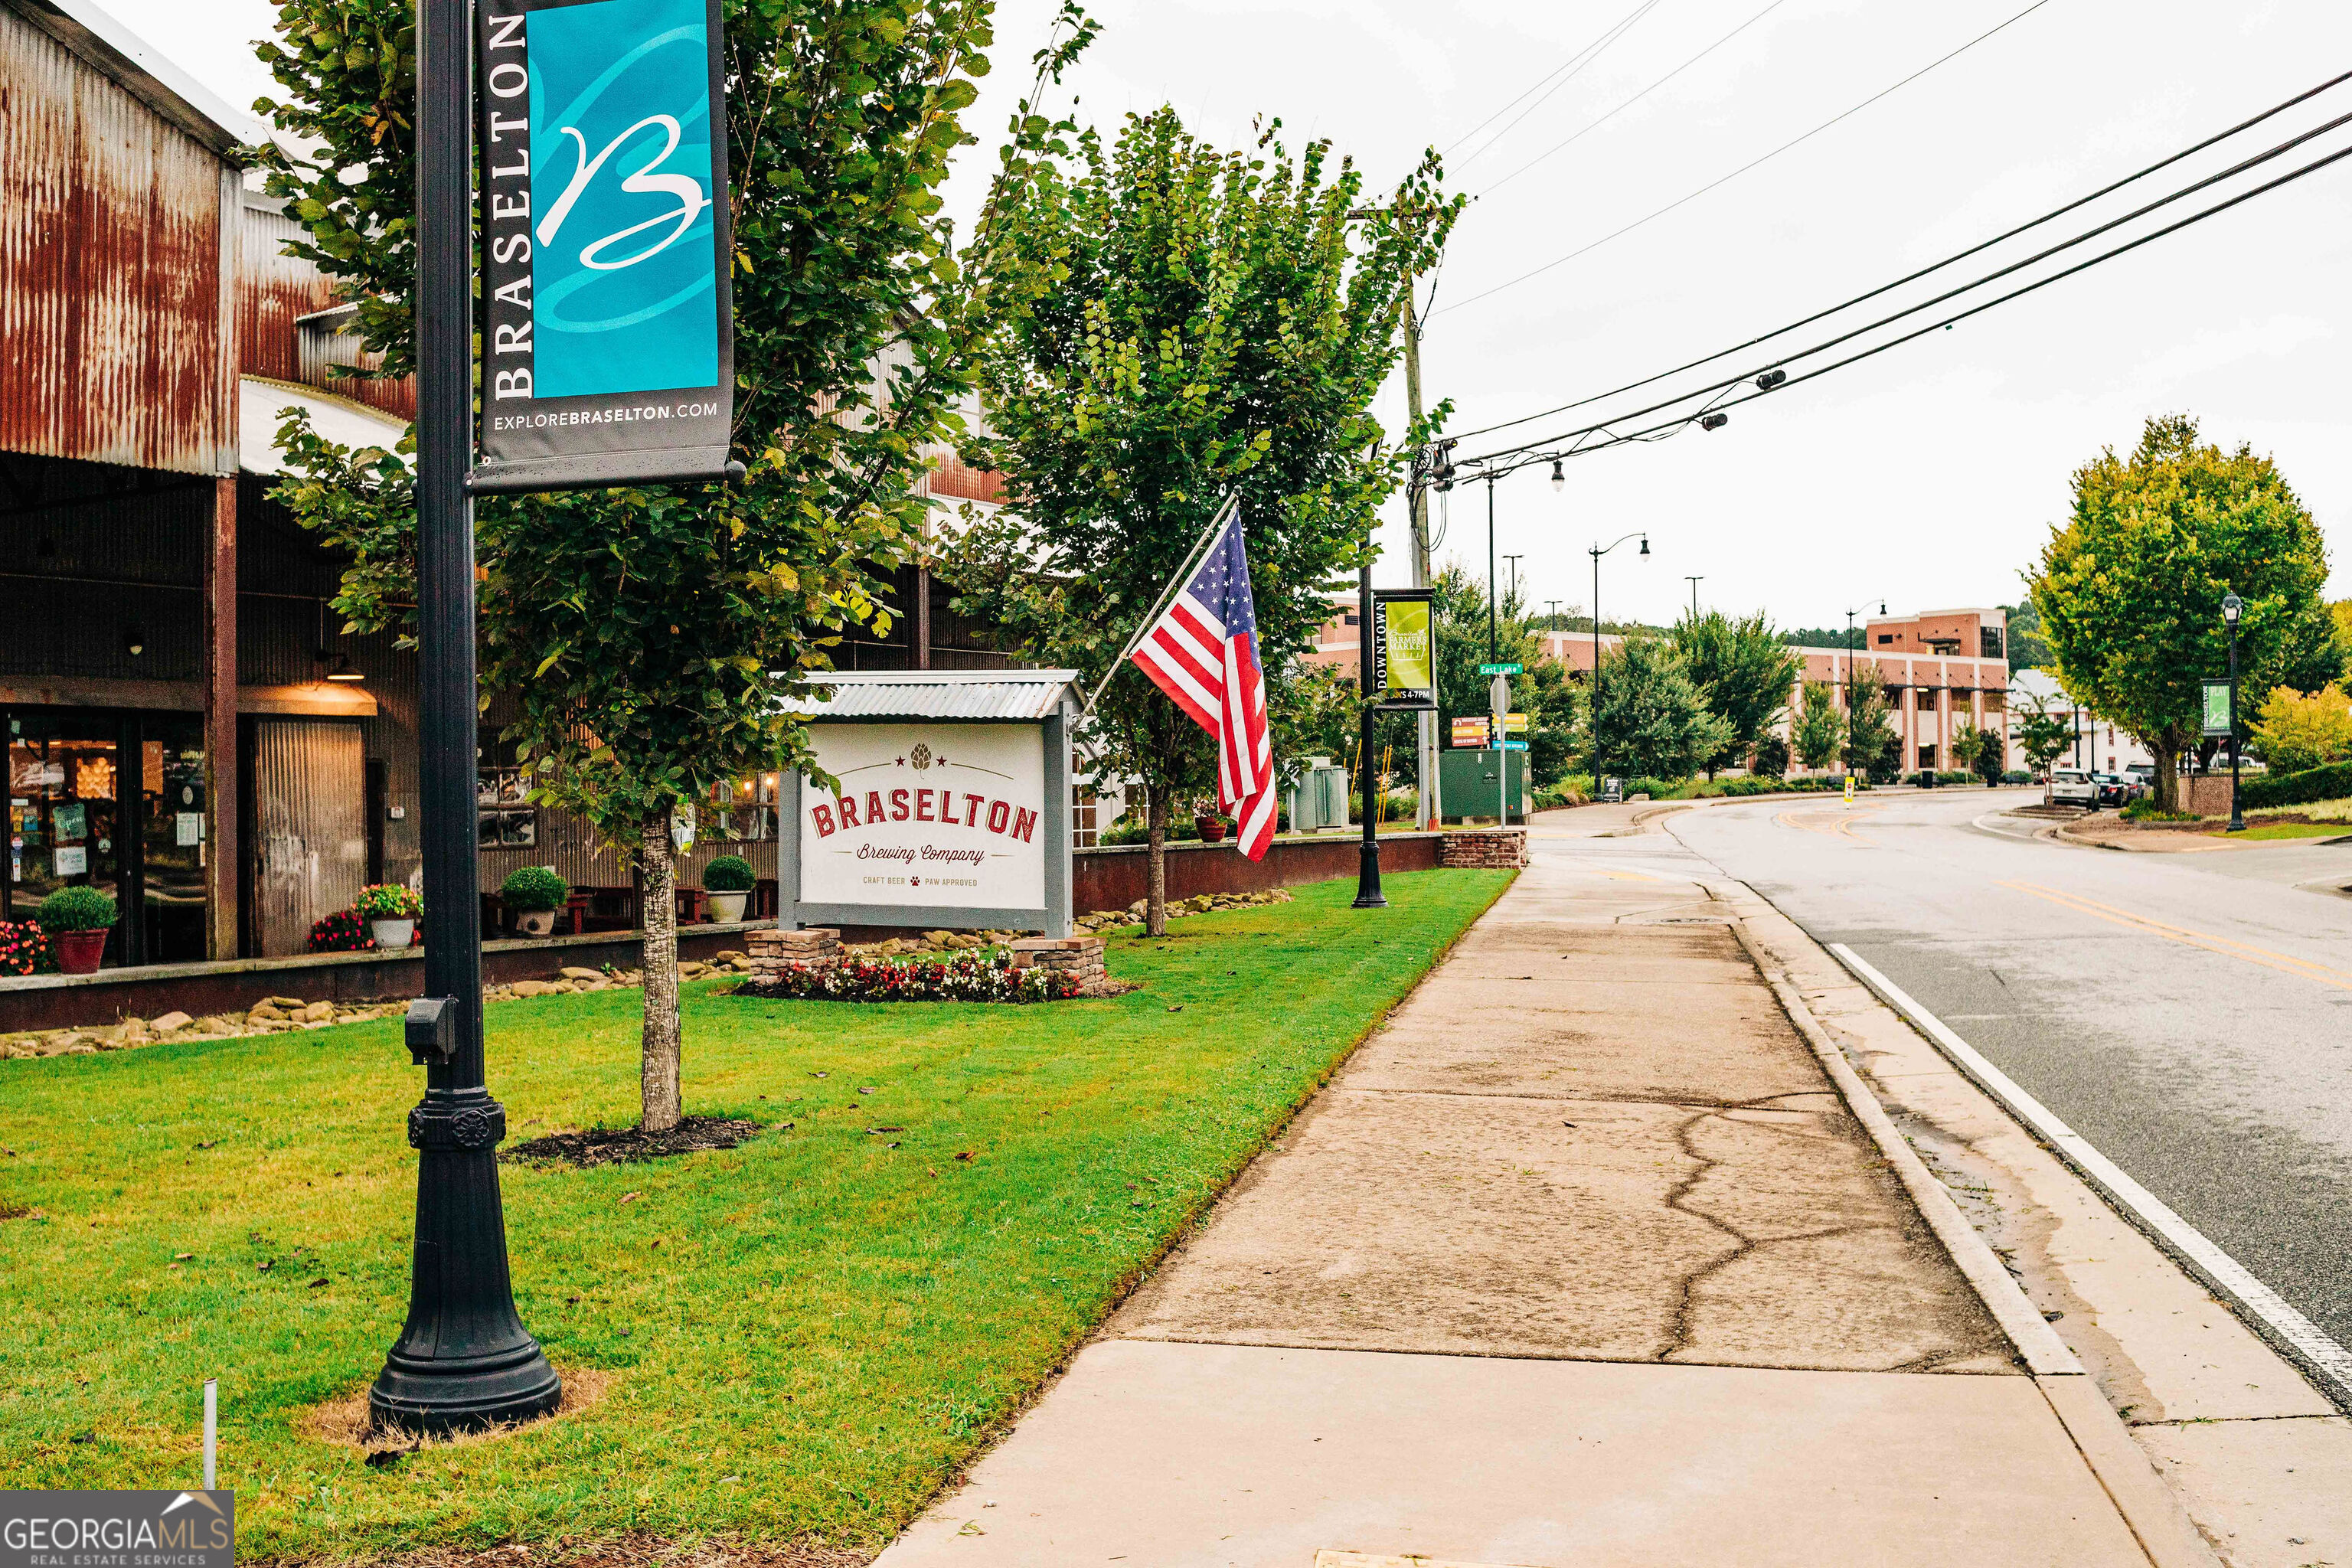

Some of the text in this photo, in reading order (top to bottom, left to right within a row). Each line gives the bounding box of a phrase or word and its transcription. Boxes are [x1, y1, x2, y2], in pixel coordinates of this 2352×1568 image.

[488, 14, 533, 401] BRASELTON
[494, 402, 718, 431] EXPLOREBRASELTON.COM
[1376, 602, 1387, 689] DOWNTOWN
[1499, 665, 1517, 674] Lake
[809, 788, 1038, 844] BRASELTON
[857, 843, 985, 866] Brewing Company
[863, 876, 885, 884] CRAFT
[887, 877, 905, 885] BEER
[942, 878, 978, 887] APPROVED
